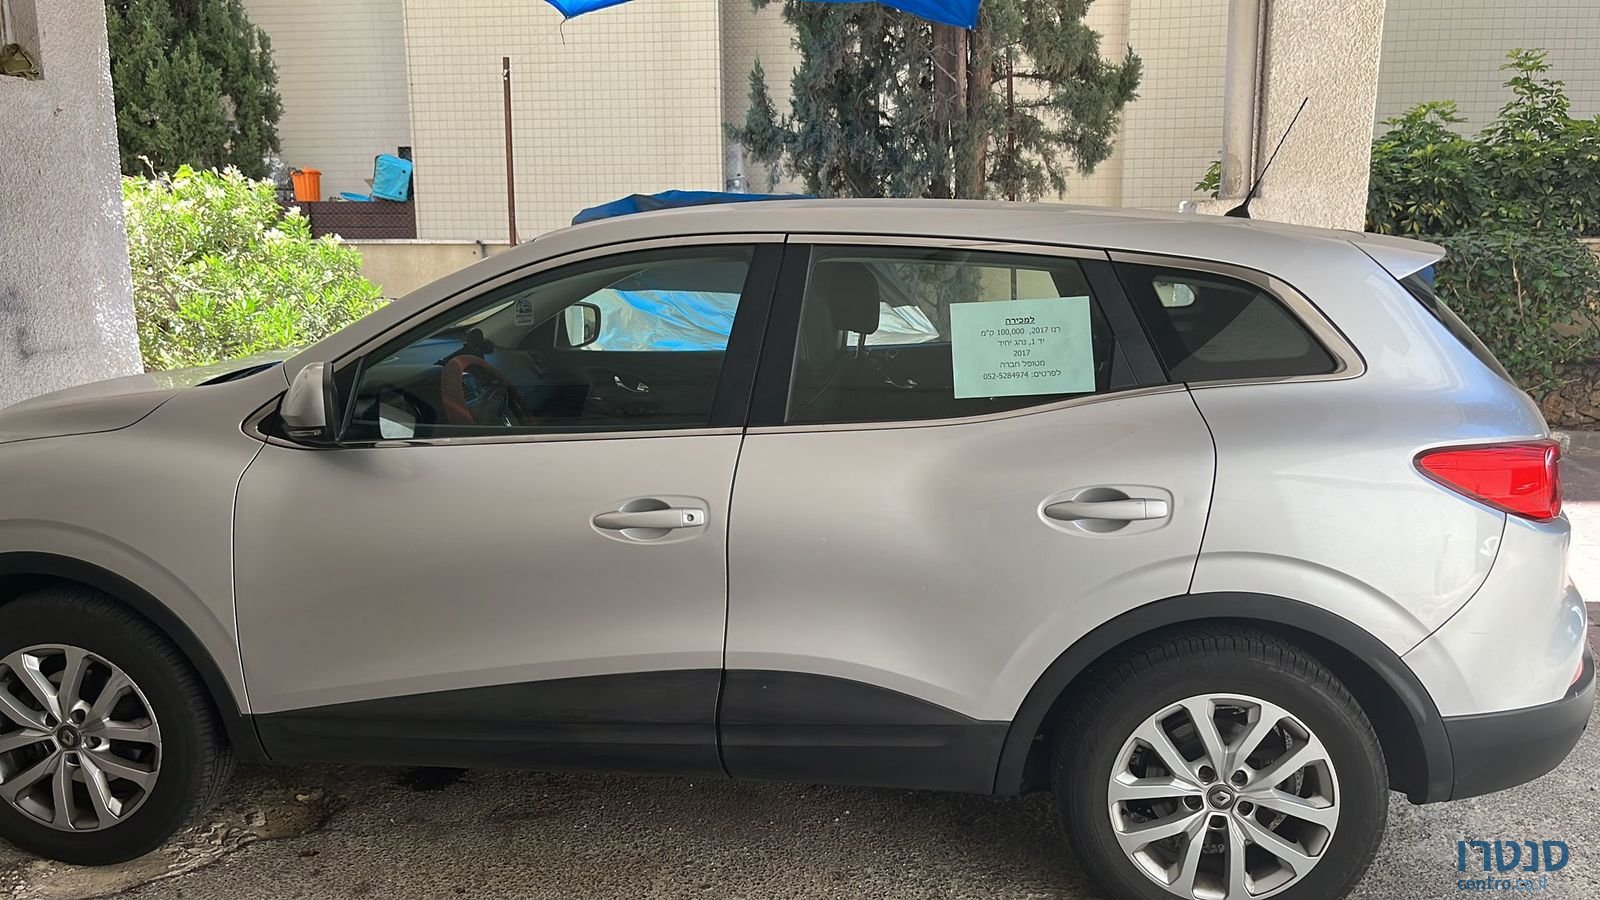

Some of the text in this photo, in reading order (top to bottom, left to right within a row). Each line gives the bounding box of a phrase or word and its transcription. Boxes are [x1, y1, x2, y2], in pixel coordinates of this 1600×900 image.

[1005, 316, 1035, 325] למכירה
[997, 328, 1025, 336] 100,000
[1013, 349, 1031, 357] 2017
[983, 369, 1062, 380] לפרטים: 052-5284974
